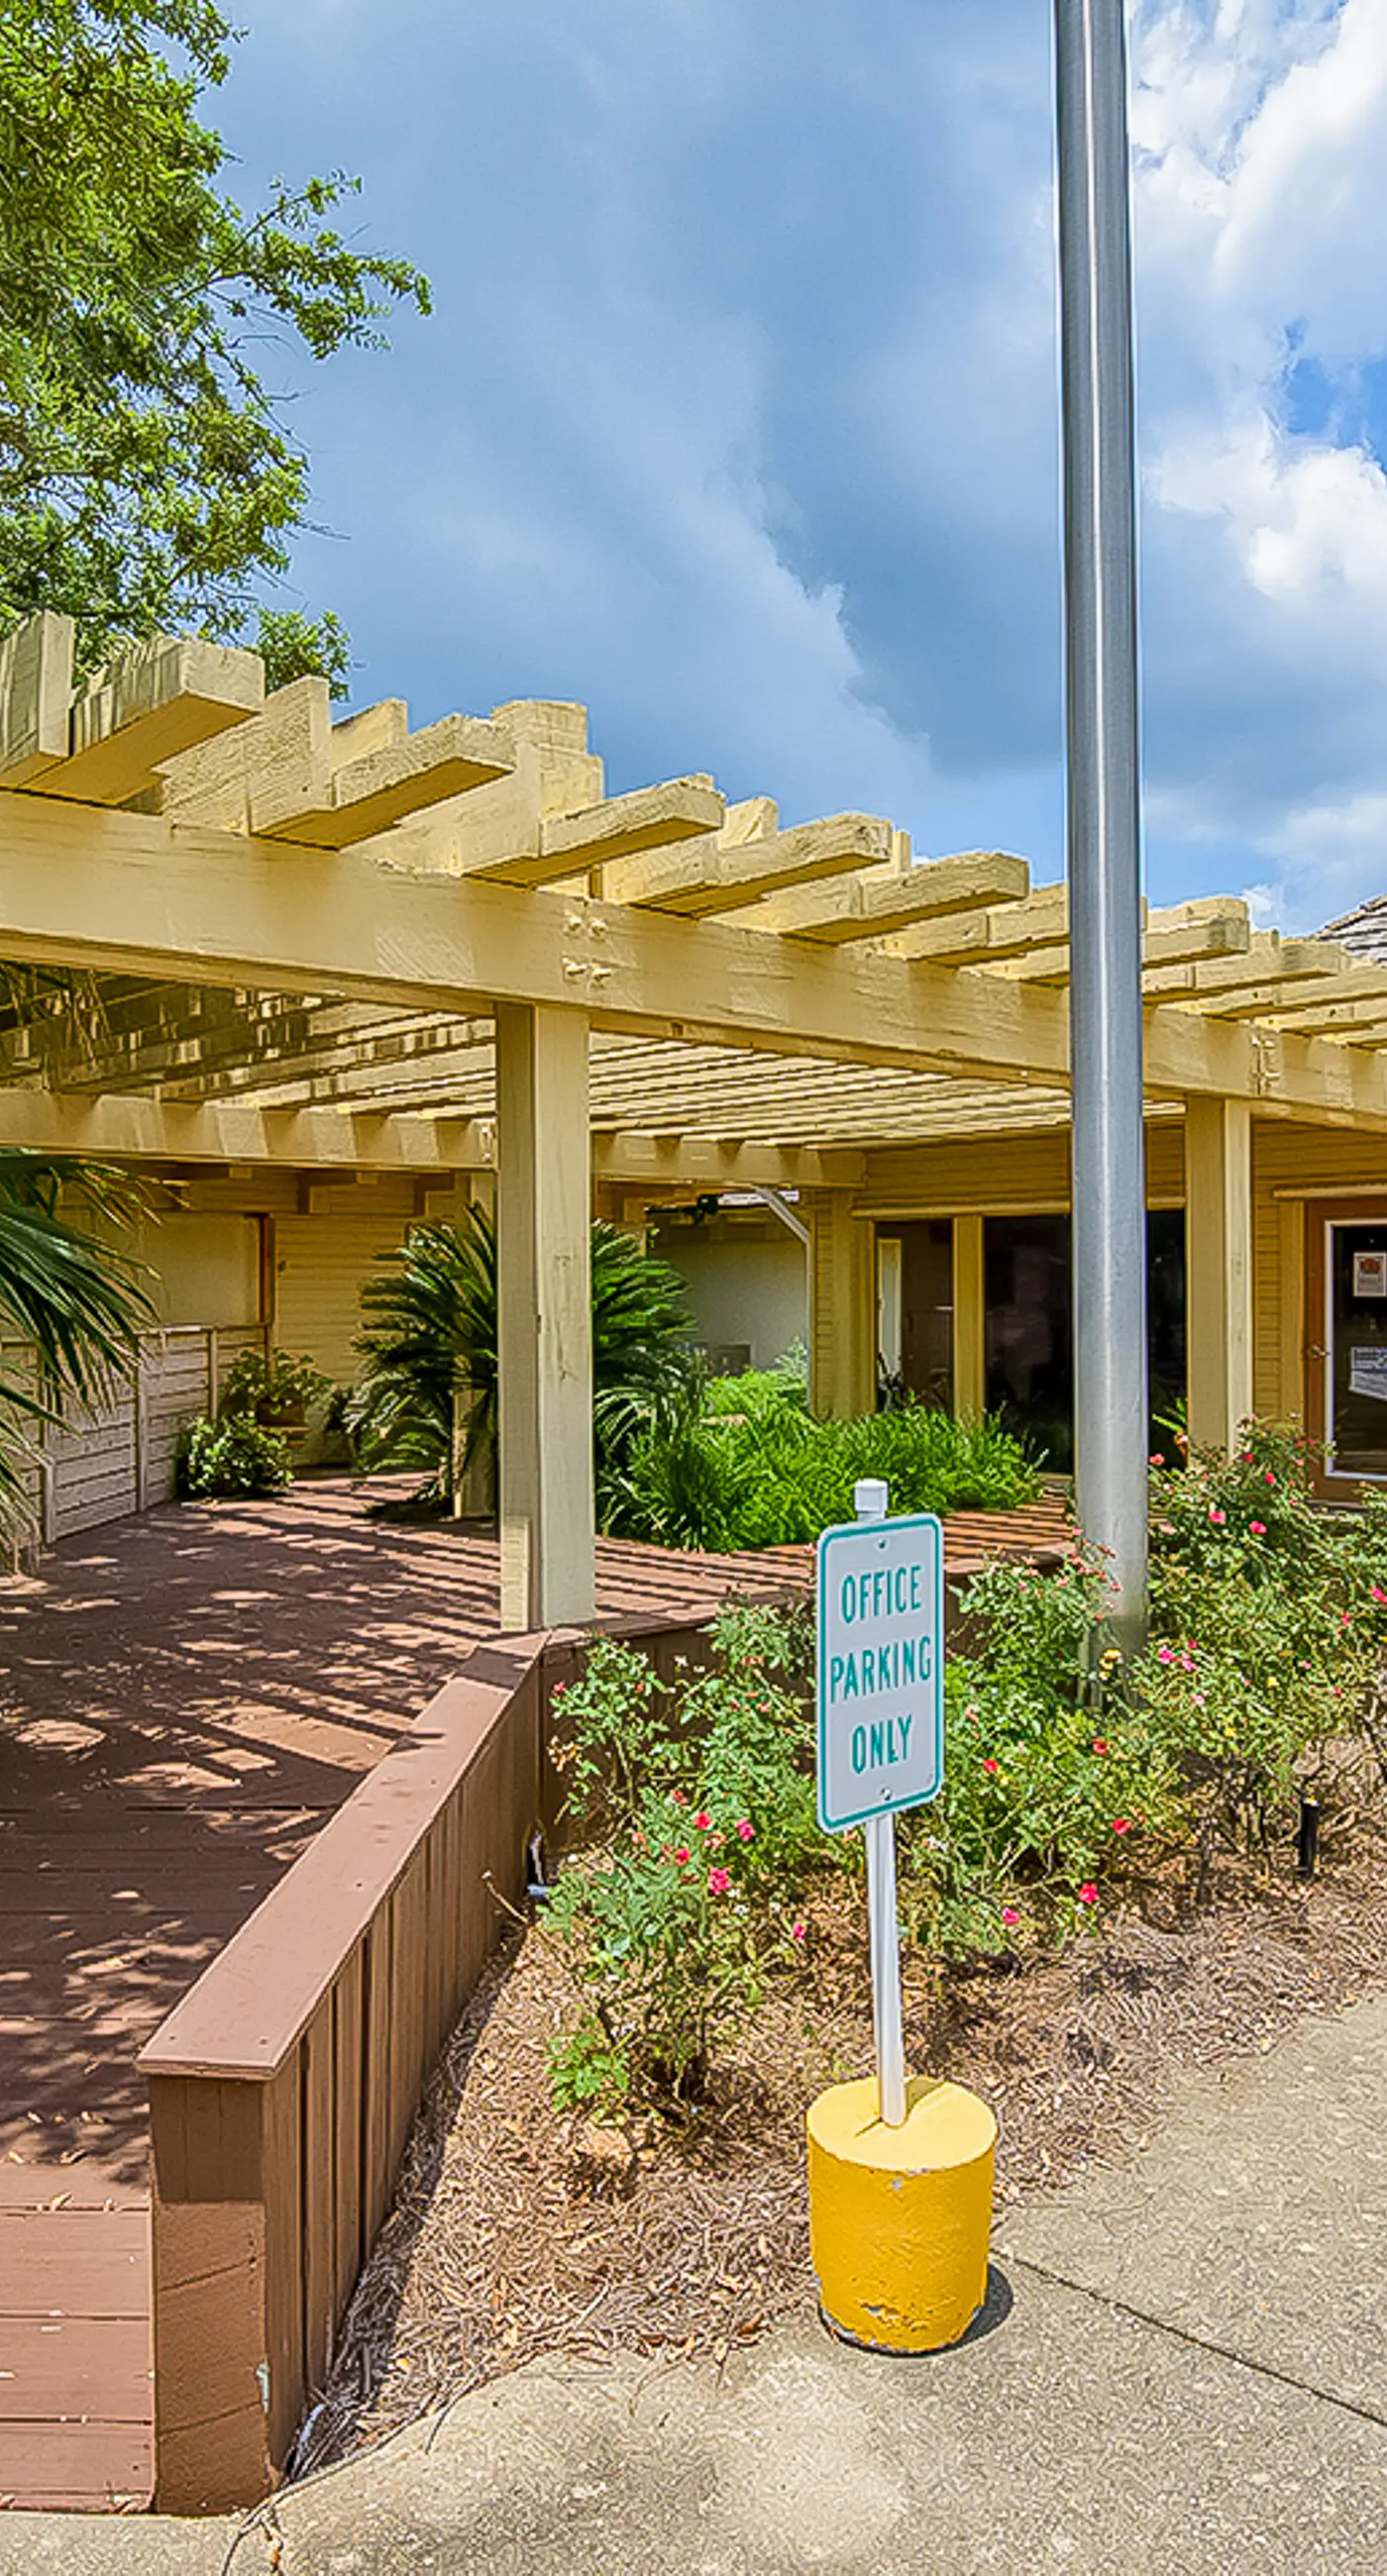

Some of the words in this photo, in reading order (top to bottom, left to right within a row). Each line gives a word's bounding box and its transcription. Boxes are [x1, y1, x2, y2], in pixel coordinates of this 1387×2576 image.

[841, 1564, 921, 1624] OFFICE
[830, 1635, 931, 1704] PARKING
[851, 1714, 912, 1775] ONLY
